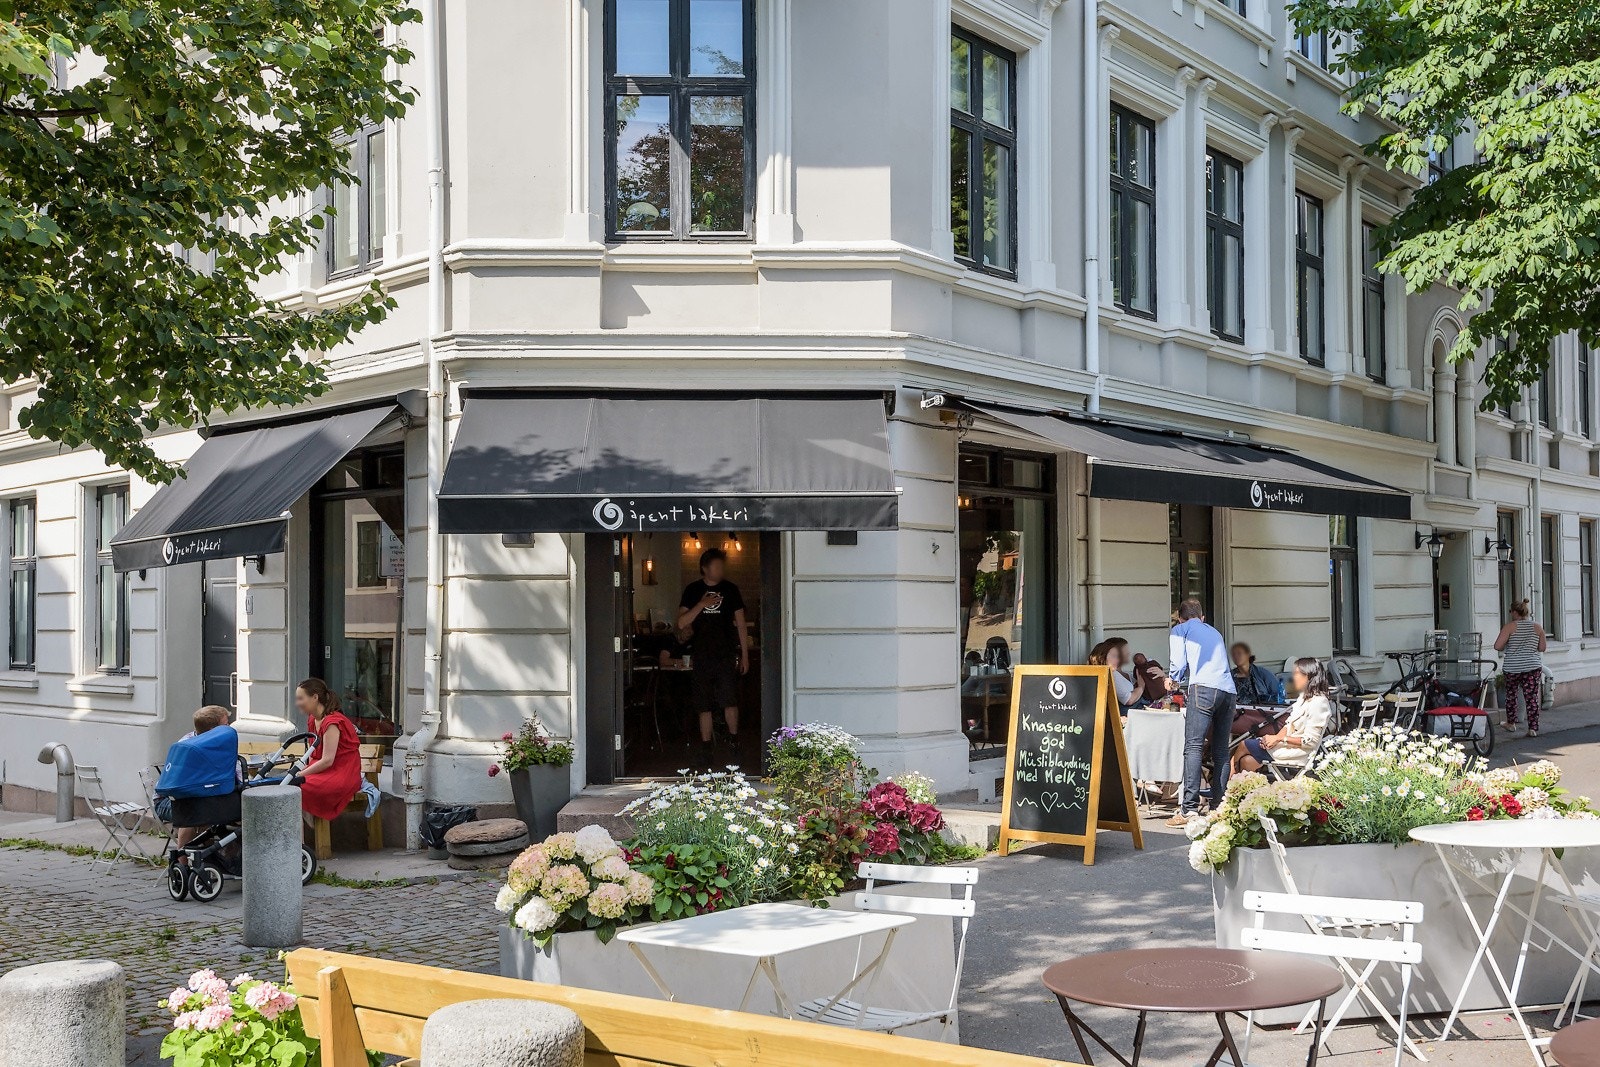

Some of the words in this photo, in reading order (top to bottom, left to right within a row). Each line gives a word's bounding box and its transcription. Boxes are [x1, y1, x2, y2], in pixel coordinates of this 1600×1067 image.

[1284, 490, 1303, 505] bakeri
[629, 501, 683, 531] åpent
[689, 505, 748, 523] bakeri
[196, 538, 220, 554] bakeri
[1022, 713, 1083, 734] Knasende
[1039, 733, 1066, 753] god
[1019, 750, 1091, 780] Müsliblandning
